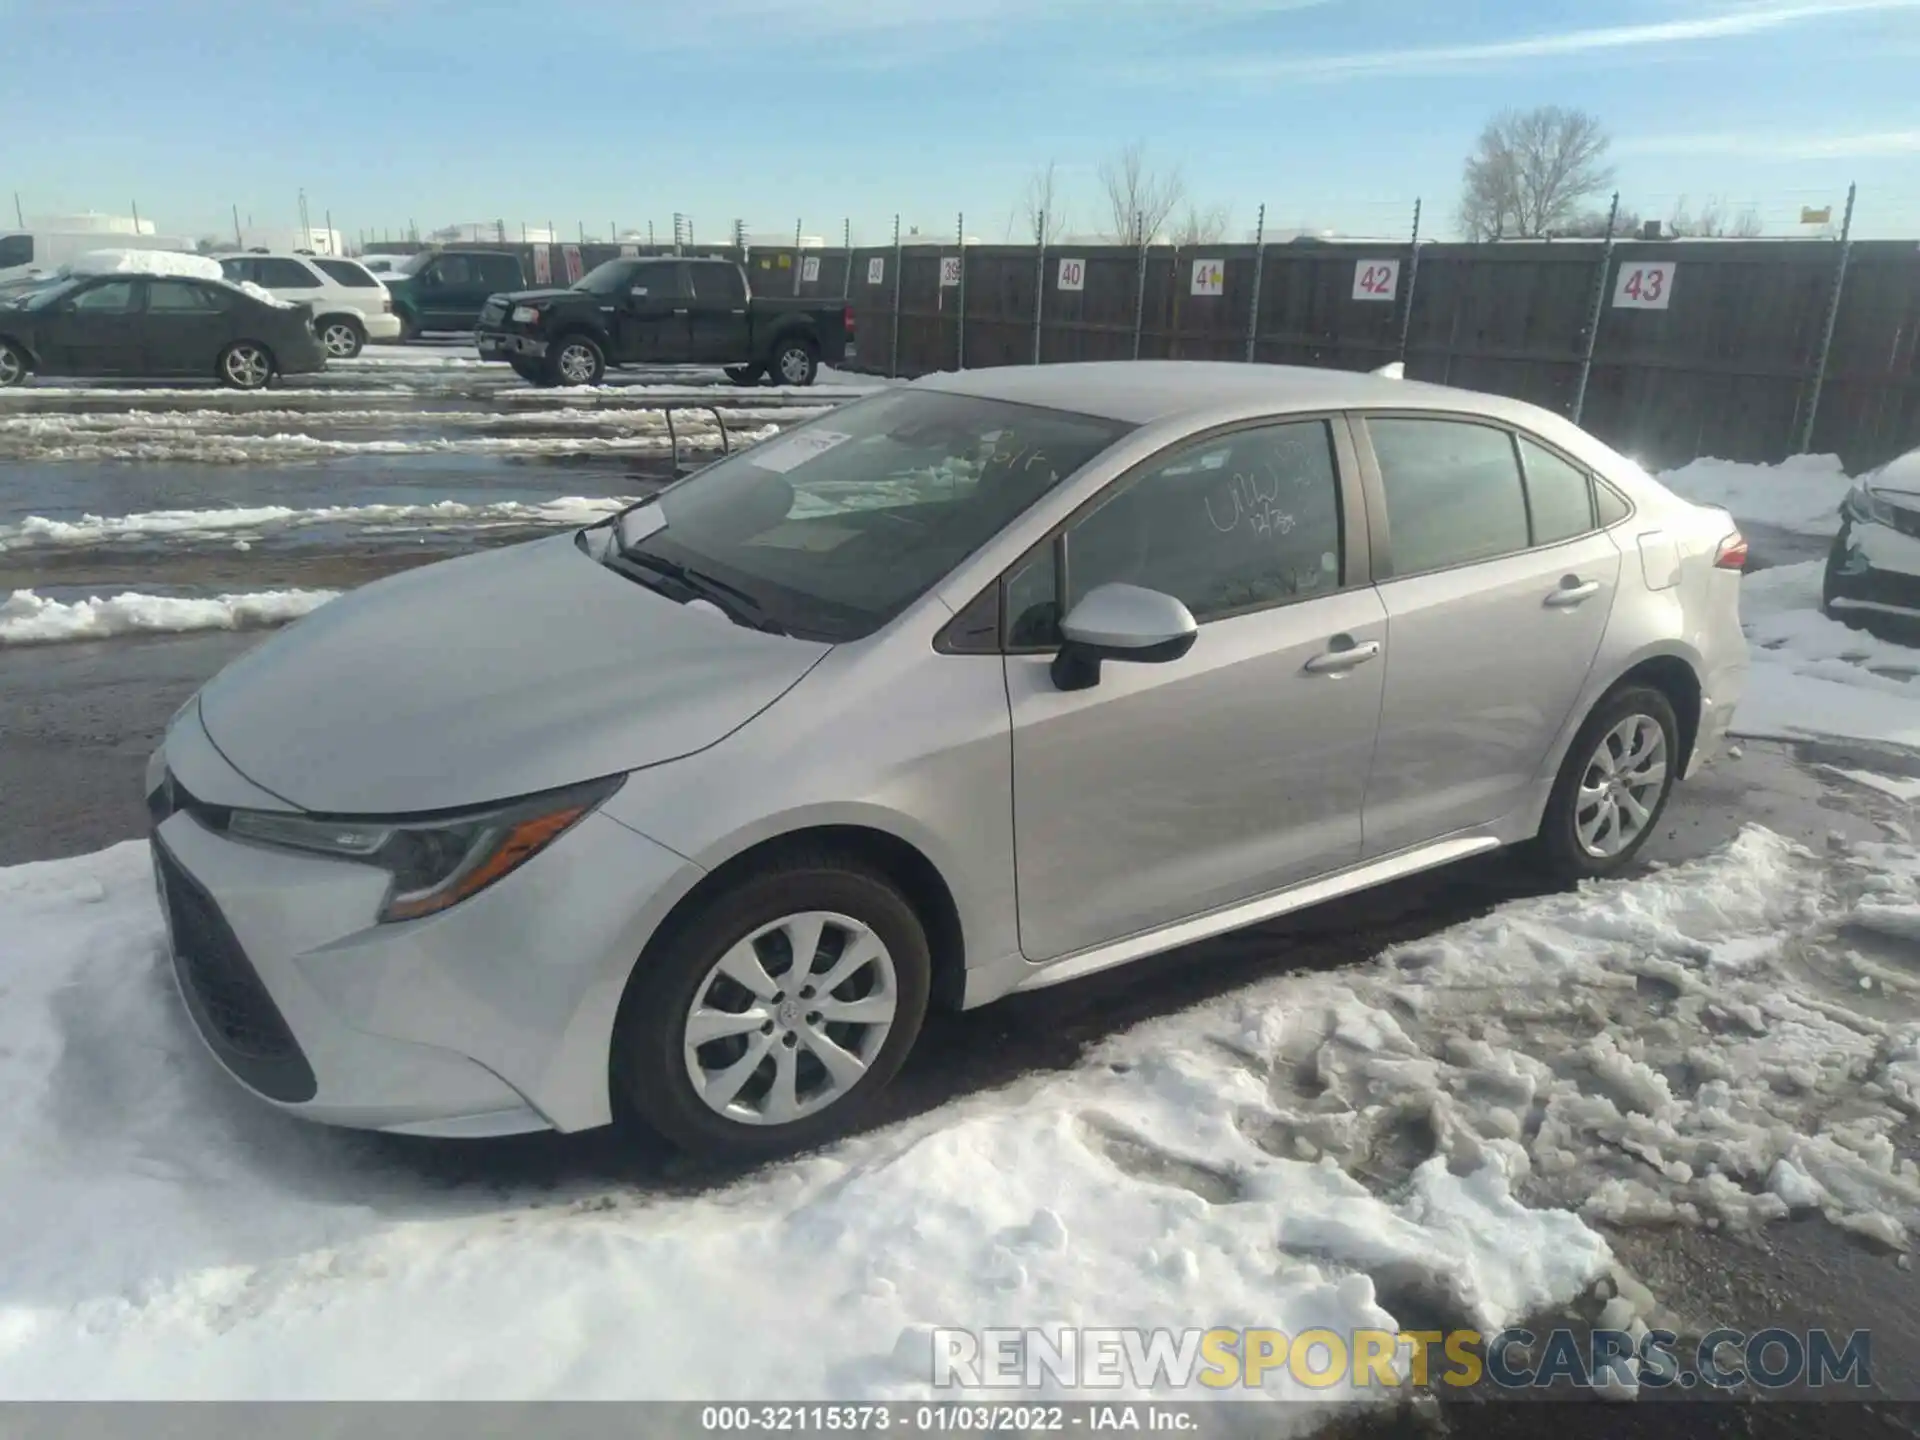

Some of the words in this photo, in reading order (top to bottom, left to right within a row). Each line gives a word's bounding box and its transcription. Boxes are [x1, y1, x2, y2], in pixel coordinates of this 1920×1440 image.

[1062, 263, 1080, 285] 40
[1196, 264, 1218, 290] 41
[1360, 266, 1391, 293] 42
[1623, 268, 1664, 302] 43
